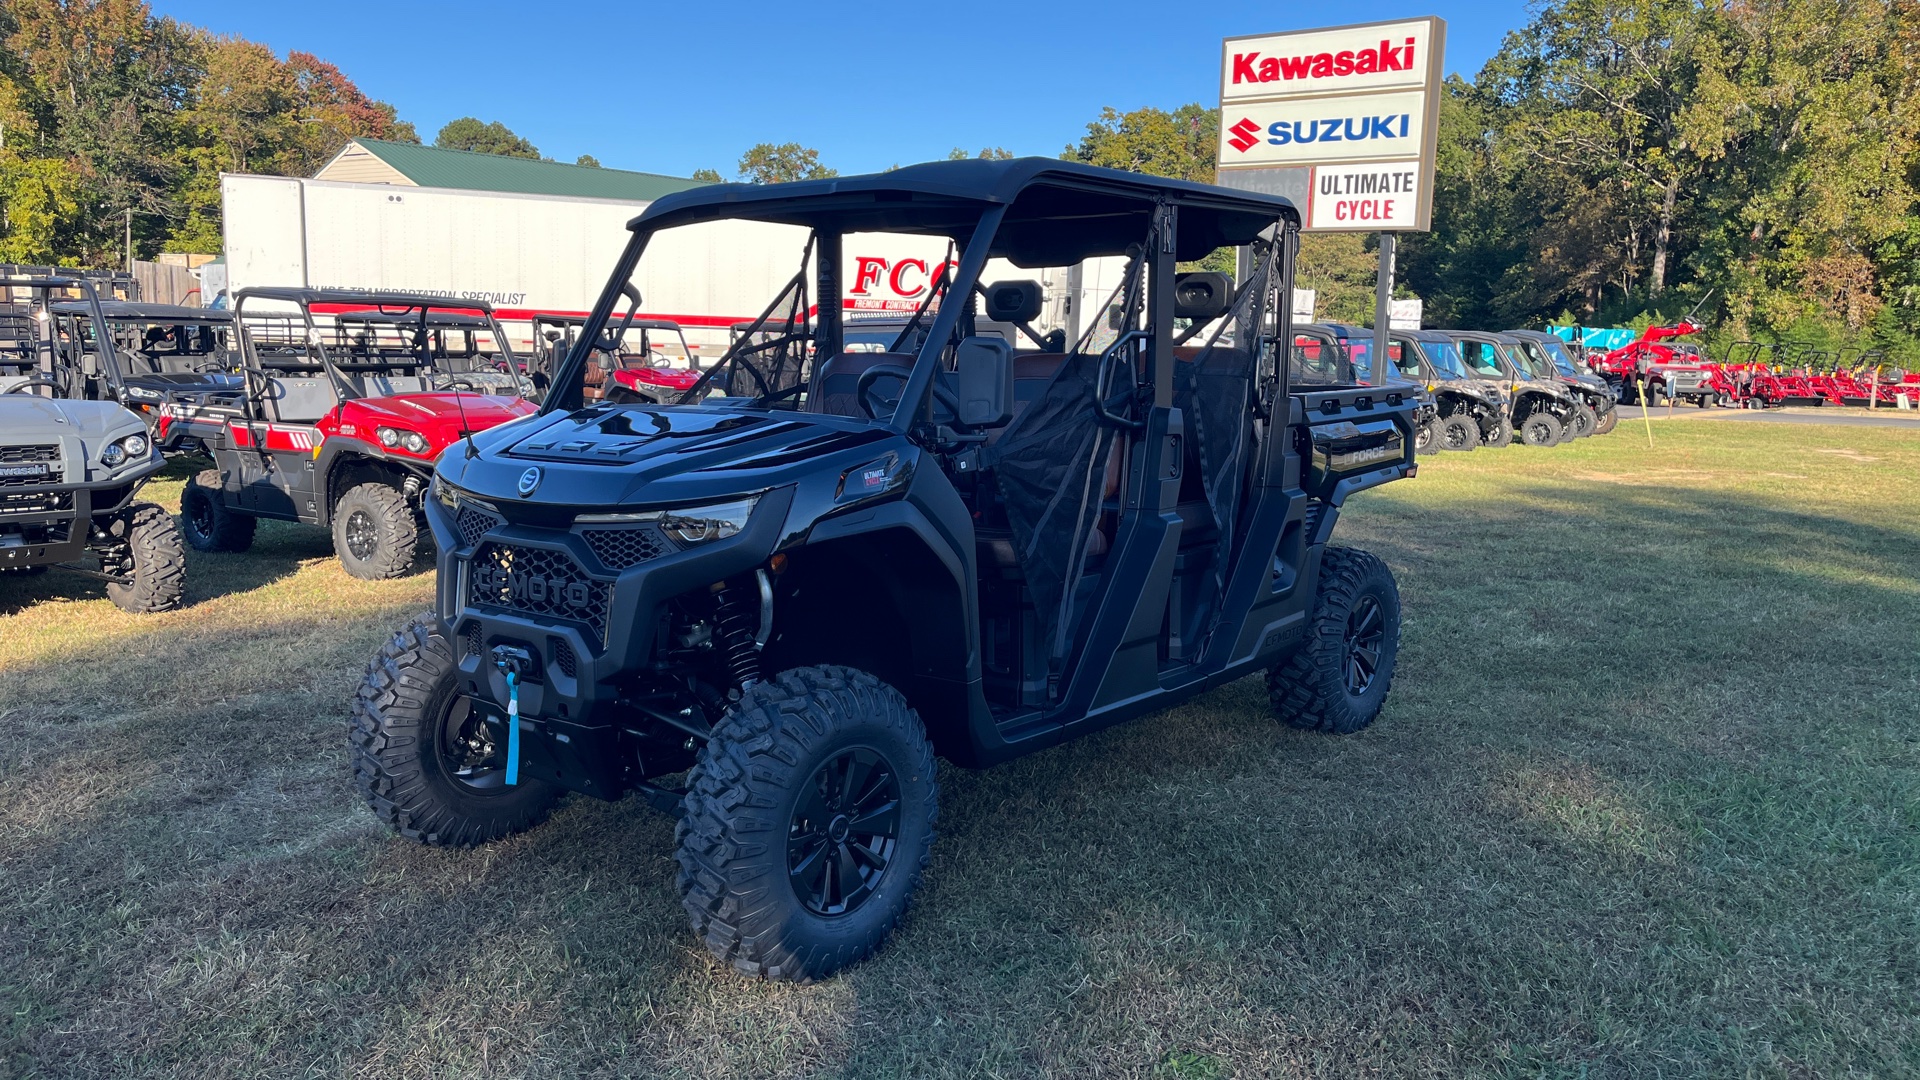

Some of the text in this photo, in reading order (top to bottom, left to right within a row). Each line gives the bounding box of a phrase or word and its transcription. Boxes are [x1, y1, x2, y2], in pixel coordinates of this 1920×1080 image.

[1232, 37, 1415, 84] Kawasaki
[1267, 114, 1410, 146] SUZUKI
[1320, 172, 1414, 196] ULTIMATE
[1335, 200, 1395, 221] CYCLE
[461, 291, 526, 305] SPECIALIST
[854, 300, 885, 309] FREMONT
[885, 301, 917, 310] CONTRACT
[477, 566, 589, 608] CFMOTO
[1265, 624, 1303, 647] CFMOTO
